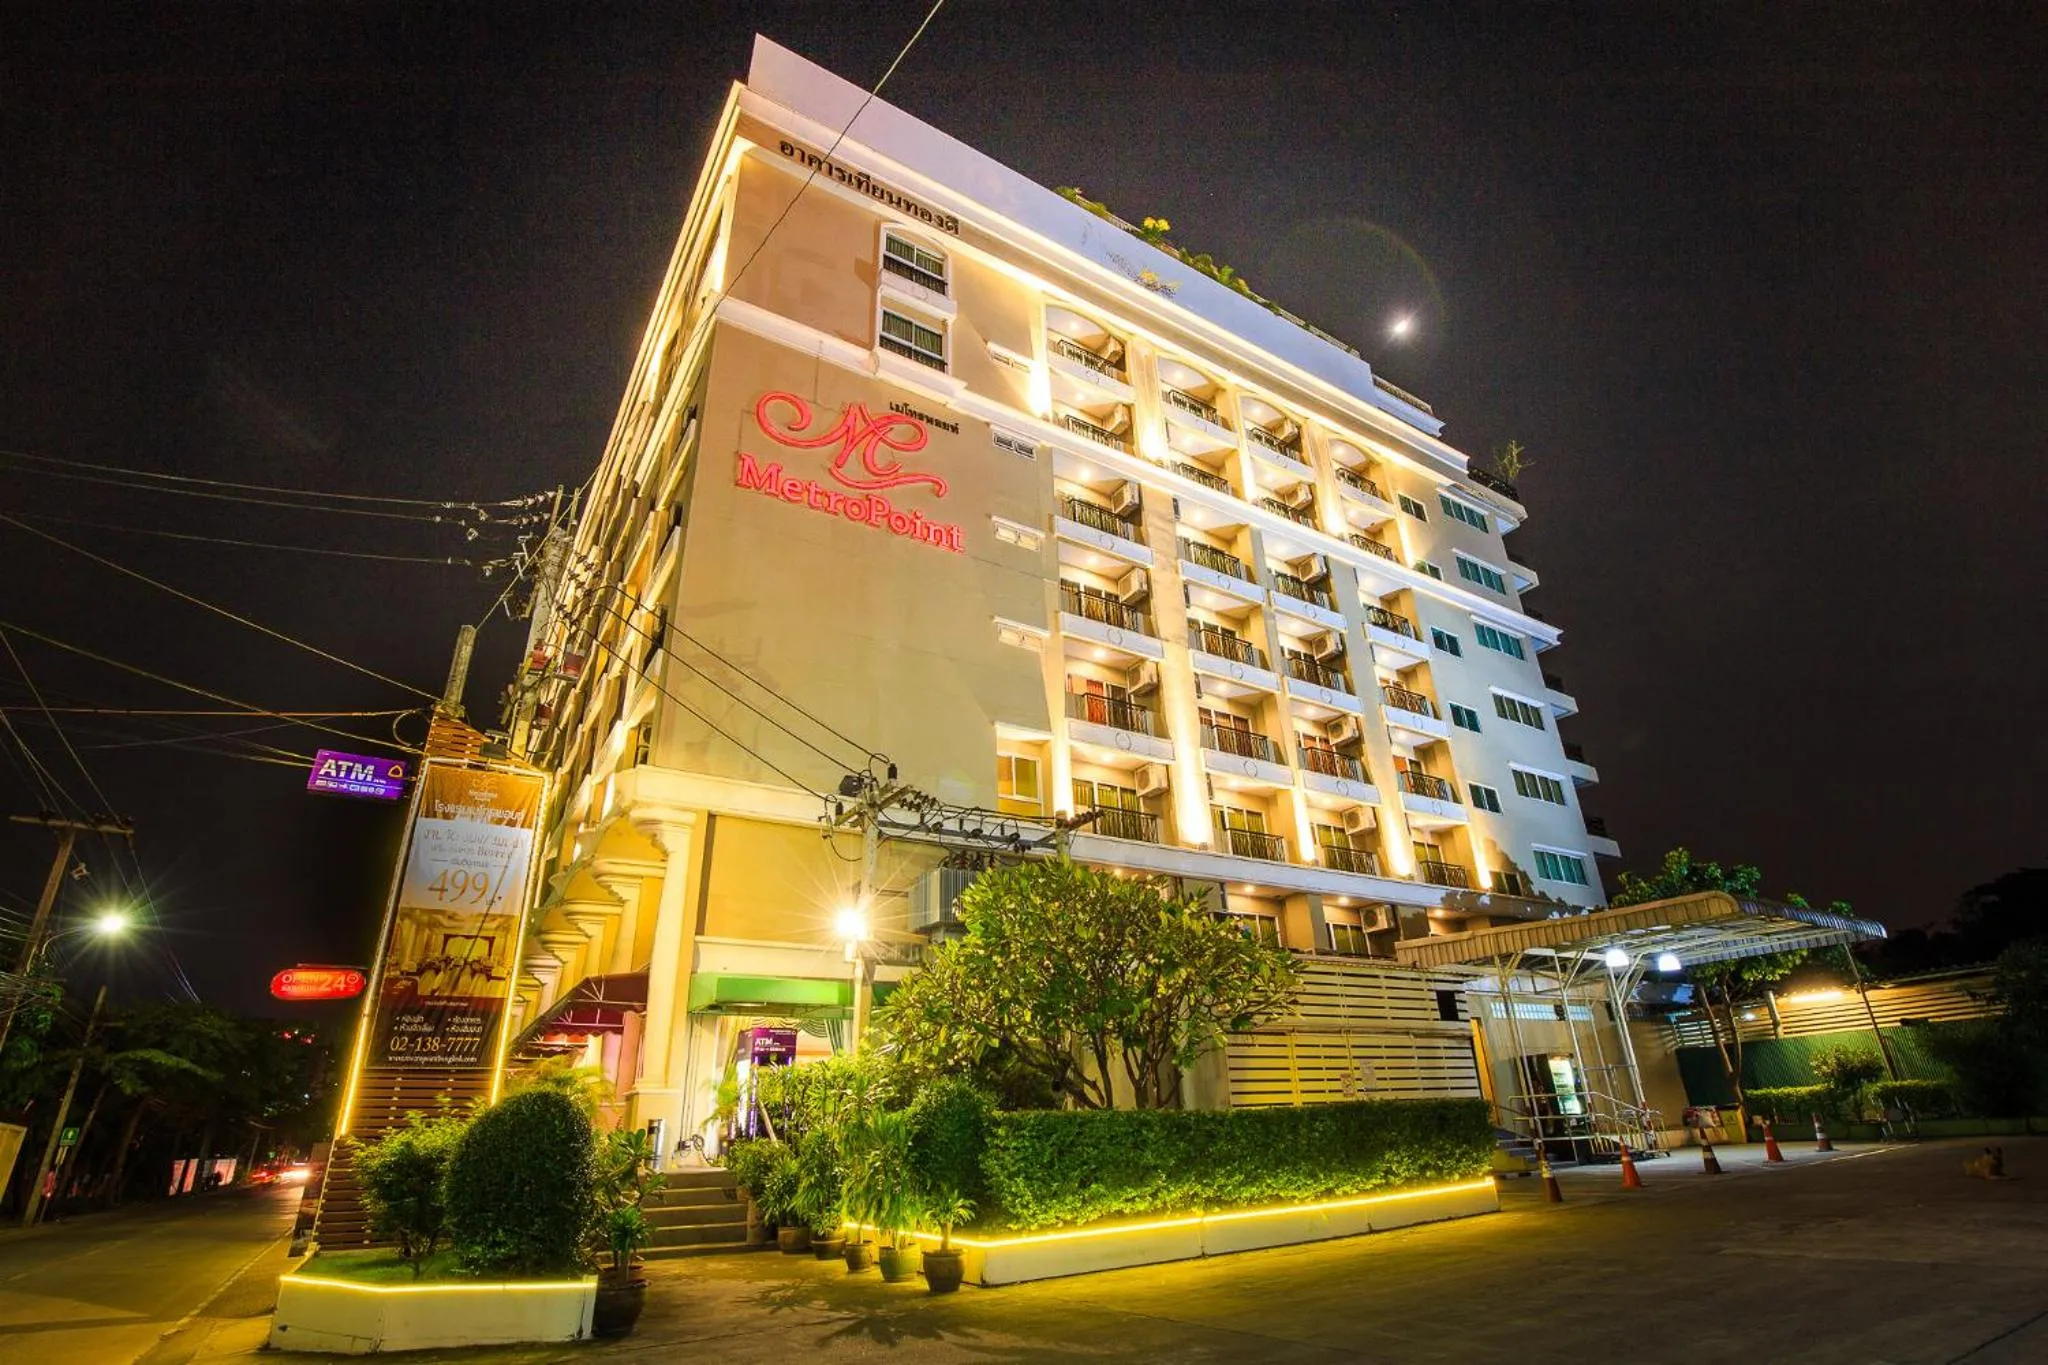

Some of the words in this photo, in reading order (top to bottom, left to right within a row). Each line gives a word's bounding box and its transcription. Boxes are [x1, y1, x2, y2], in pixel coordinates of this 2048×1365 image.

[736, 451, 966, 553] MetroPoint
[318, 758, 375, 782] ATM
[427, 868, 490, 905] 499
[318, 973, 346, 992] 24
[389, 1036, 481, 1053] 02-138-7777
[754, 1037, 773, 1047] ATM
